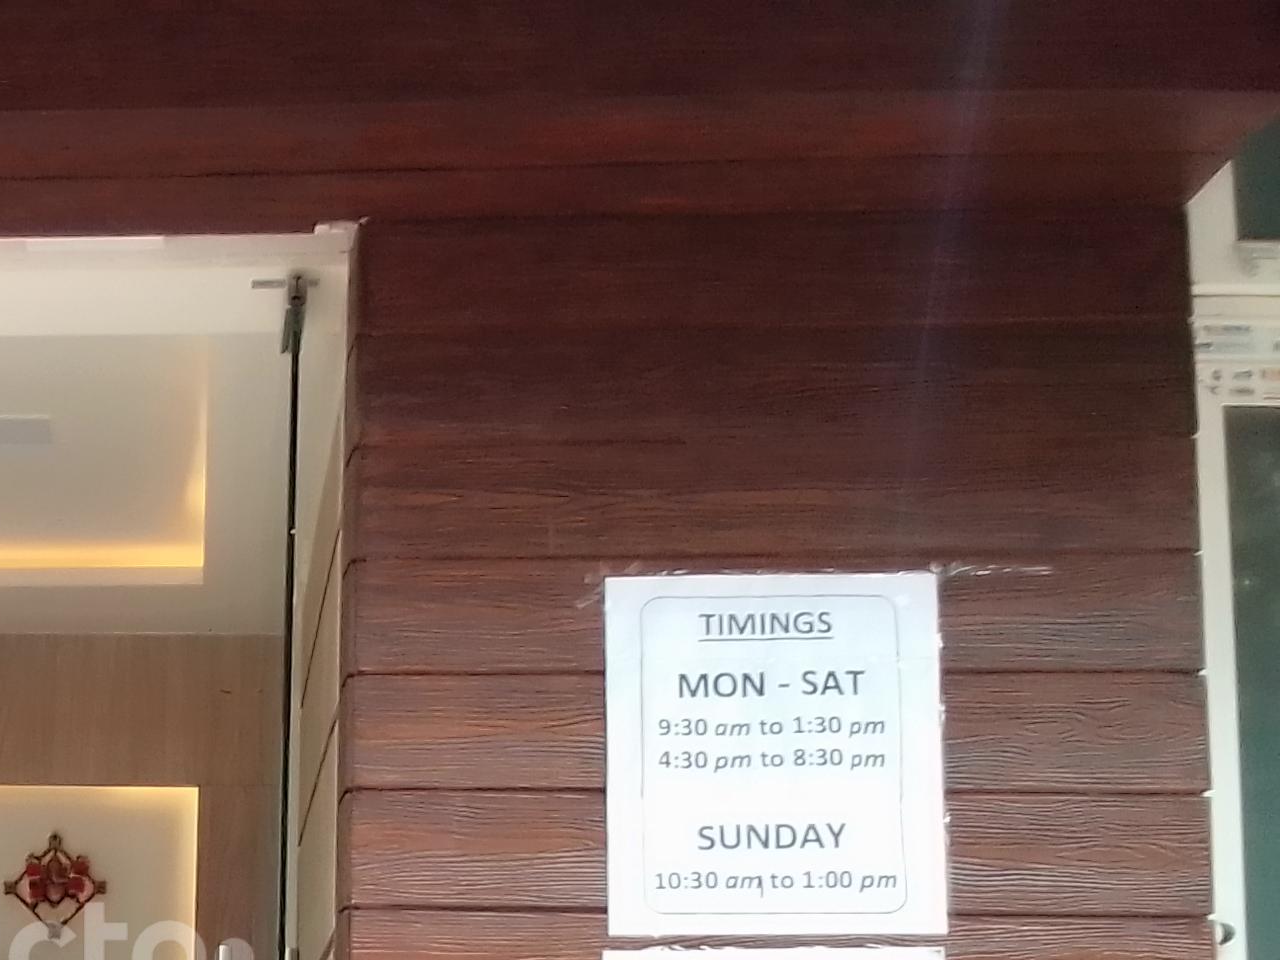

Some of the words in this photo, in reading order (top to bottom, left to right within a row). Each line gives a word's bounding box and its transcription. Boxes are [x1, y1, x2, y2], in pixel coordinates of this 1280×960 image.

[697, 611, 833, 635] TIMINGS
[677, 671, 766, 698] MON
[801, 669, 867, 696] SAT
[658, 718, 708, 737] 9:30
[714, 722, 751, 737] am
[759, 719, 784, 736] to
[792, 715, 842, 734] 1:30
[848, 720, 886, 739] pm
[658, 750, 708, 769] 4:30
[713, 754, 752, 773] pm
[760, 751, 785, 768] to
[793, 748, 843, 767] 8:30
[849, 753, 886, 771] pm
[697, 822, 847, 851] SUNDAY
[655, 871, 719, 890] 10:30
[725, 875, 763, 890] am
[770, 873, 795, 890] to
[802, 870, 853, 889] 1:00
[858, 874, 897, 894] pm
